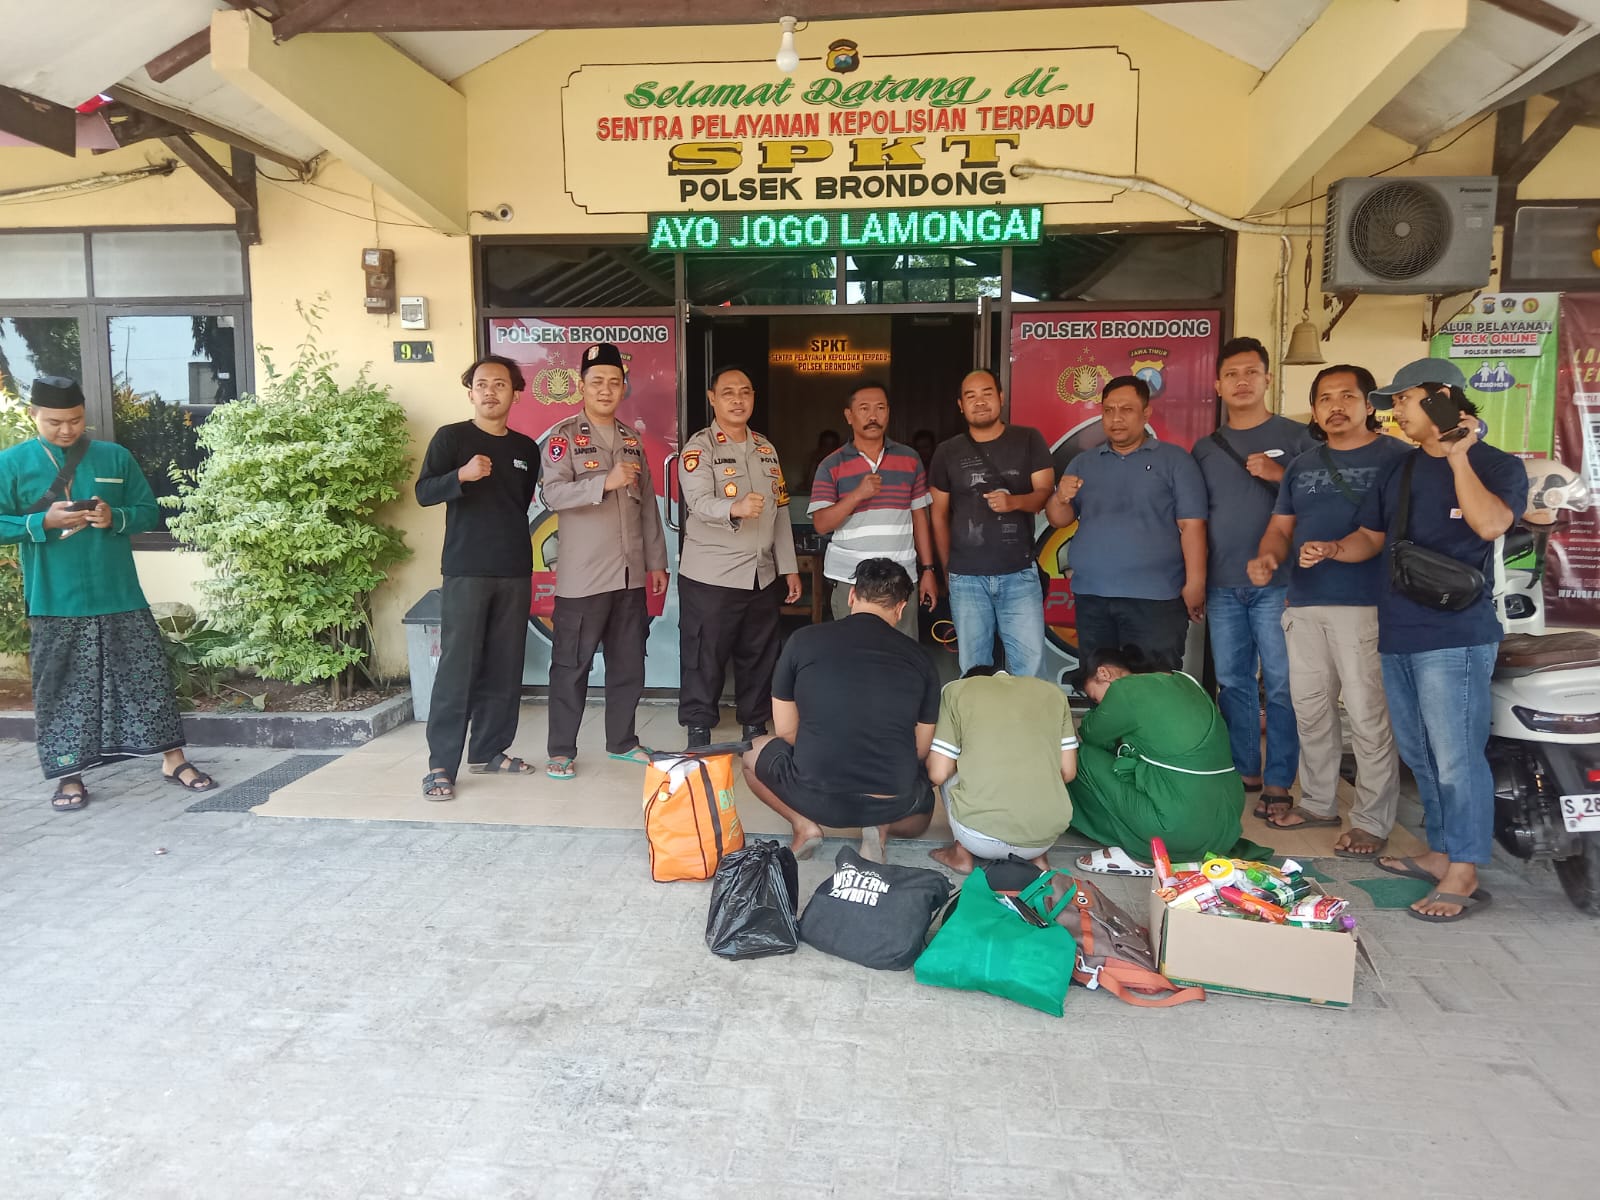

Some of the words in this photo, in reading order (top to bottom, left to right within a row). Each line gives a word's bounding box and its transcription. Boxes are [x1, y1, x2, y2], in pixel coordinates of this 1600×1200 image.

[624, 77, 795, 109] Selamat
[802, 74, 991, 108] Datang
[1005, 67, 1068, 98] di
[596, 115, 683, 141] SENTRA
[691, 112, 820, 139] PELAYANAN
[829, 108, 966, 136] KEPOLISIAN
[976, 103, 1094, 131] TERPADU
[668, 133, 1020, 176] SPKT
[680, 177, 803, 202] POLSEK
[815, 171, 1006, 200] BRONDONG
[650, 216, 719, 248] AYO
[729, 214, 829, 247] JOGO
[496, 327, 567, 344] POLSEK
[569, 326, 668, 343] BRONDONG
[1021, 321, 1097, 339] POLSEK
[1101, 319, 1210, 338] BRONDONG
[1440, 322, 1473, 332] ALUR
[1476, 321, 1552, 332] PELAYANAN
[811, 339, 848, 352] SPKT
[1454, 334, 1487, 344] SKCK
[1491, 333, 1537, 344] ONLINE
[400, 343, 412, 360] 9
[1564, 799, 1575, 814] S
